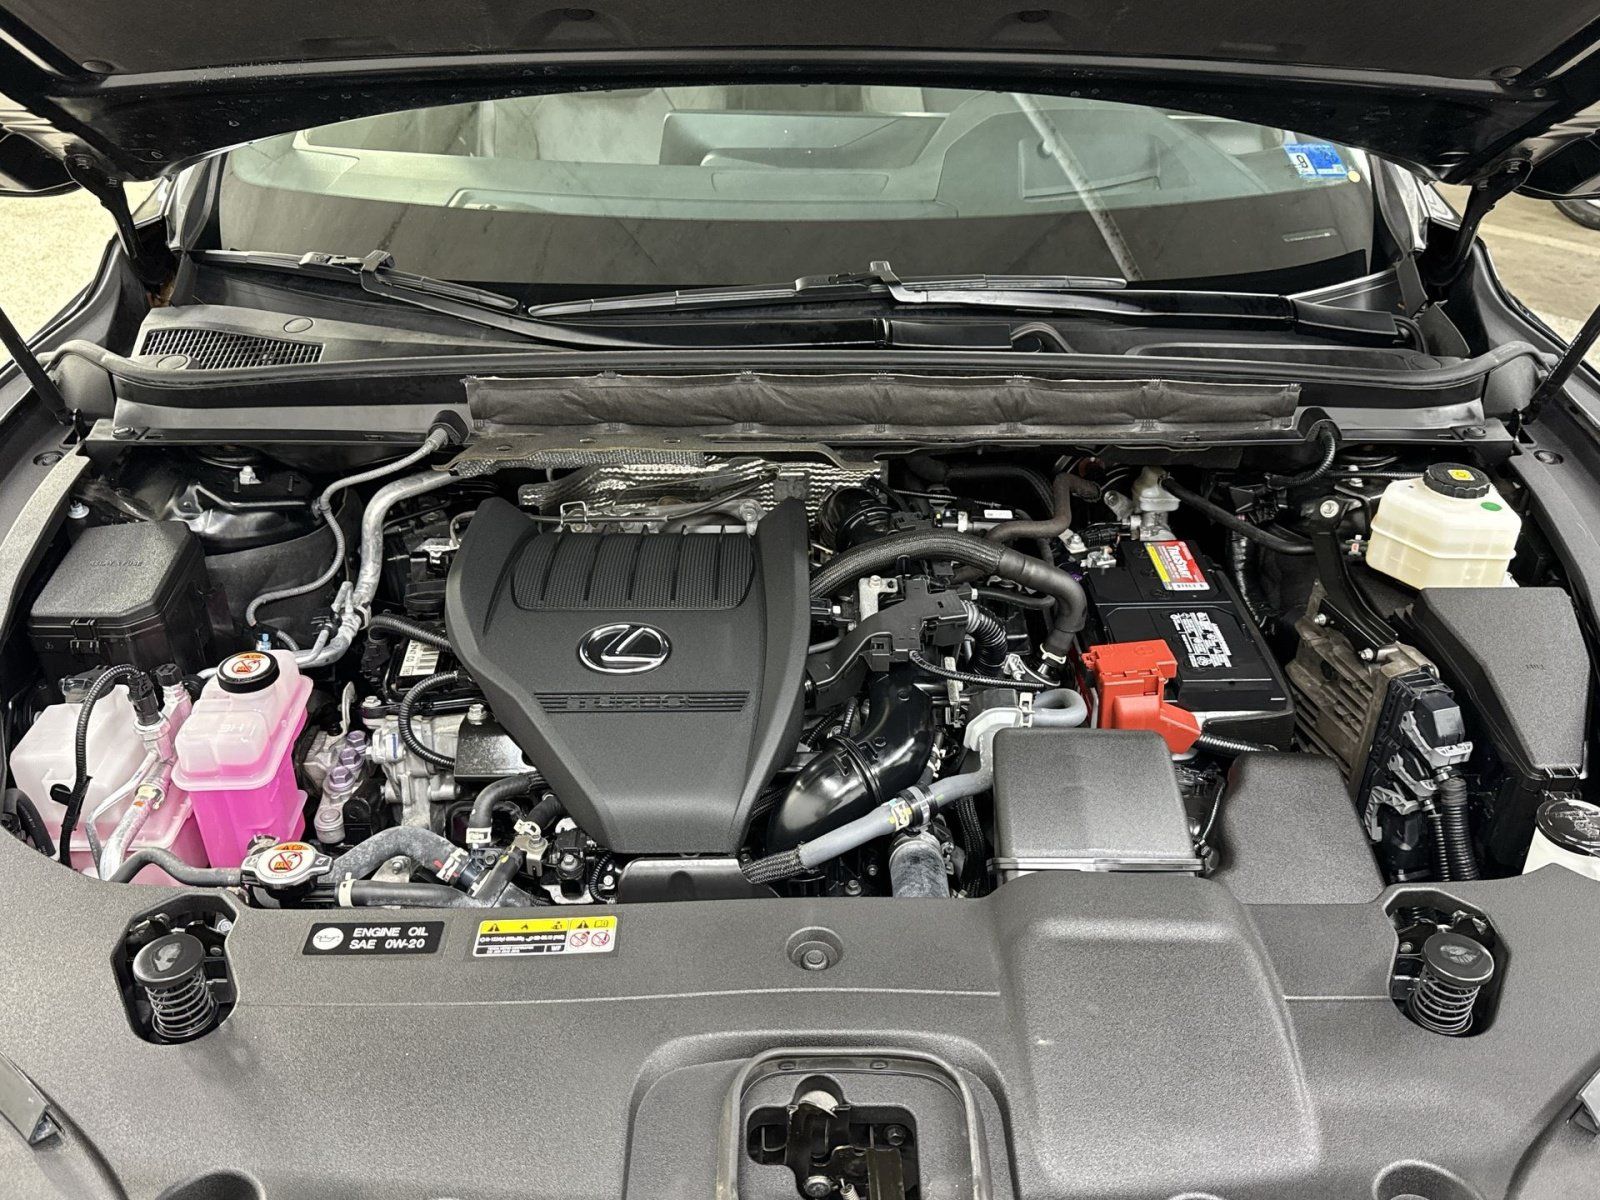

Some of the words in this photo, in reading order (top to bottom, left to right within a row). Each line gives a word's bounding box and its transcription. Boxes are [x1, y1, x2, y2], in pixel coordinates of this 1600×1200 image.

[352, 927, 401, 938] ENGINE
[407, 926, 429, 937] OIL
[349, 939, 377, 950] SAE
[384, 938, 426, 949] 0W-20
